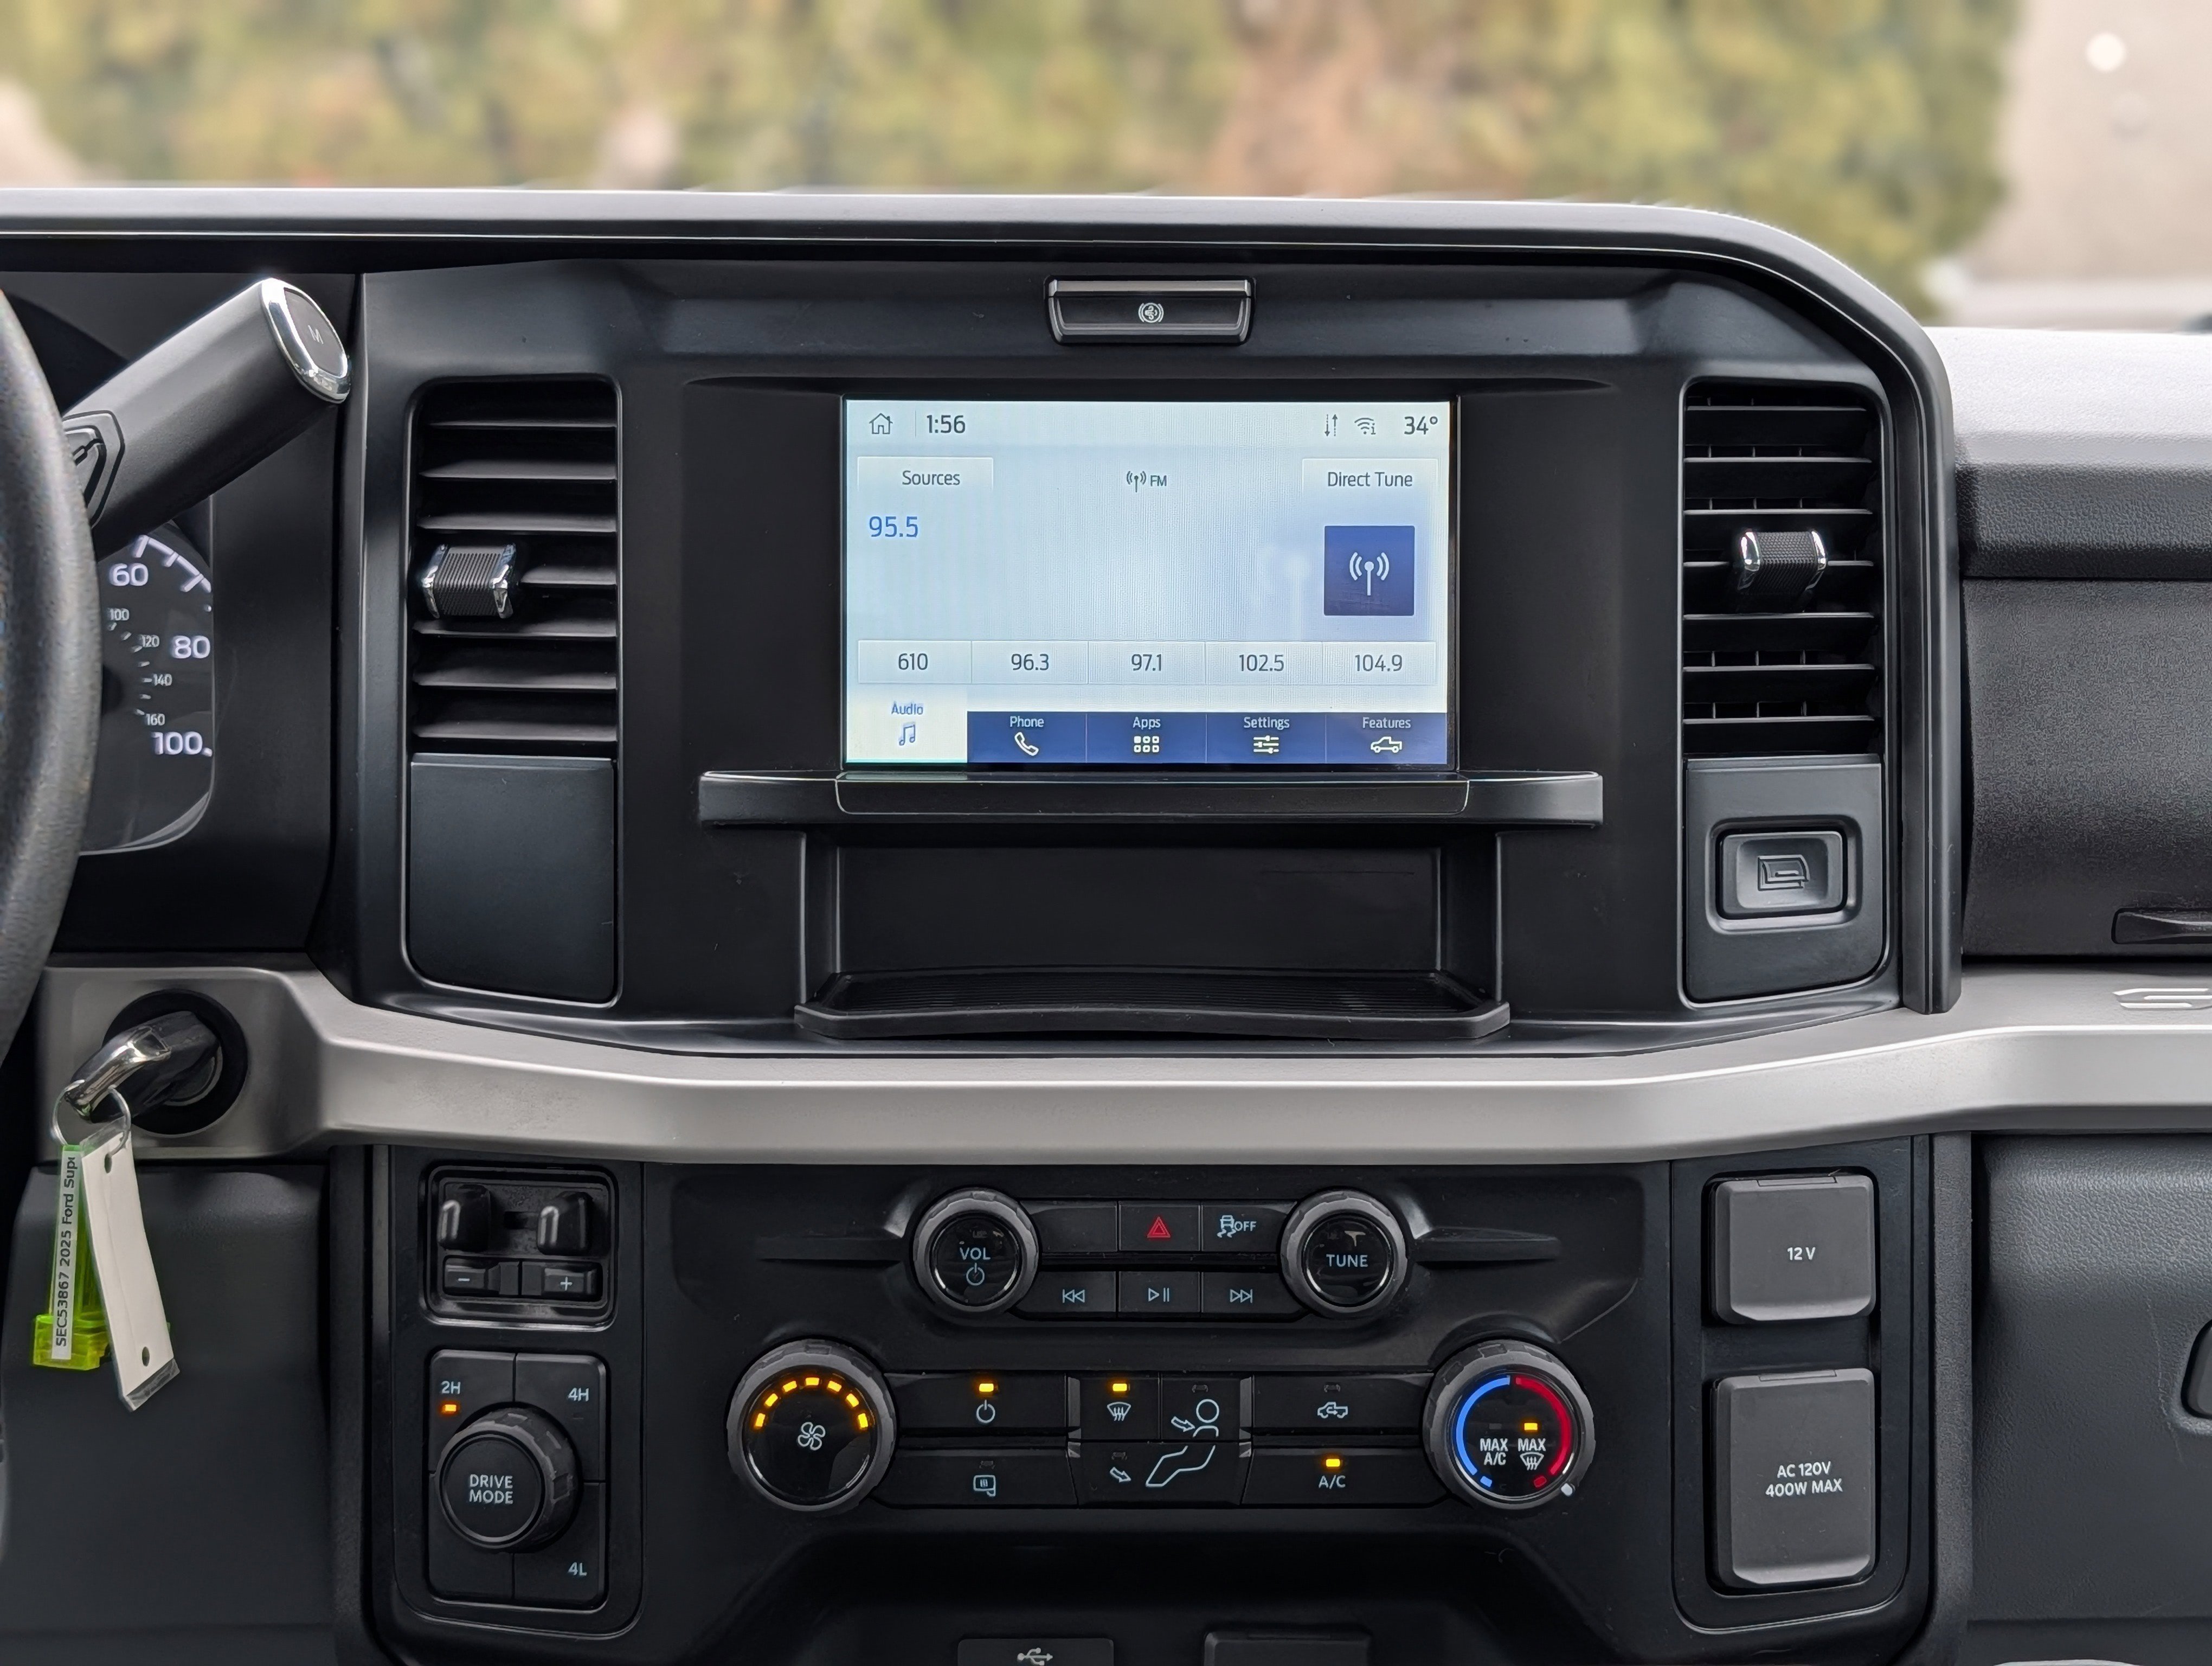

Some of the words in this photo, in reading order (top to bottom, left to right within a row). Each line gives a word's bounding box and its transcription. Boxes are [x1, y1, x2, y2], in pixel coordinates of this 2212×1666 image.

[926, 414, 966, 434] 1:56
[1403, 416, 1438, 435] 34°
[902, 470, 961, 486] Sources
[1150, 475, 1167, 487] FM
[1327, 471, 1371, 487] Direct
[1374, 471, 1413, 487] Tune
[869, 516, 919, 537] 95.5
[110, 562, 149, 586] 60
[109, 608, 130, 621] 100
[141, 634, 160, 648] 120
[171, 635, 211, 659] 80
[897, 652, 929, 671] 610
[1011, 653, 1050, 671] 96.3
[1131, 653, 1162, 671] 97.1
[1239, 654, 1284, 672] 102.5
[1355, 654, 1403, 672] 104.9
[152, 673, 173, 687] 140
[891, 700, 924, 716] Audio
[145, 713, 166, 726] 160
[1009, 715, 1045, 728] Phone
[1132, 716, 1161, 730] Apps
[1243, 716, 1290, 730] Settings
[1362, 716, 1411, 729] Features
[151, 731, 203, 755] 100
[61, 1193, 74, 1225] Ford
[1233, 1220, 1257, 1232] OFF
[59, 1229, 72, 1267] 2025
[959, 1247, 992, 1260] VOL
[1787, 1247, 1803, 1261] 12
[1805, 1247, 1816, 1260] V
[1326, 1253, 1369, 1268] TUNE
[55, 1271, 71, 1347] SEC53867
[441, 1381, 461, 1395] 2H
[568, 1387, 590, 1402] 4H
[1480, 1438, 1508, 1452] MAX
[1517, 1438, 1546, 1452] MAX
[1483, 1451, 1507, 1466] A/C
[1777, 1464, 1796, 1479] AC
[1798, 1461, 1832, 1476] 120V
[469, 1474, 513, 1489] DRIVE
[1318, 1475, 1346, 1489] A/C
[1765, 1481, 1807, 1497] 400W
[1811, 1478, 1843, 1494] MAX
[468, 1489, 514, 1505] MODE
[568, 1562, 588, 1577] 4L
